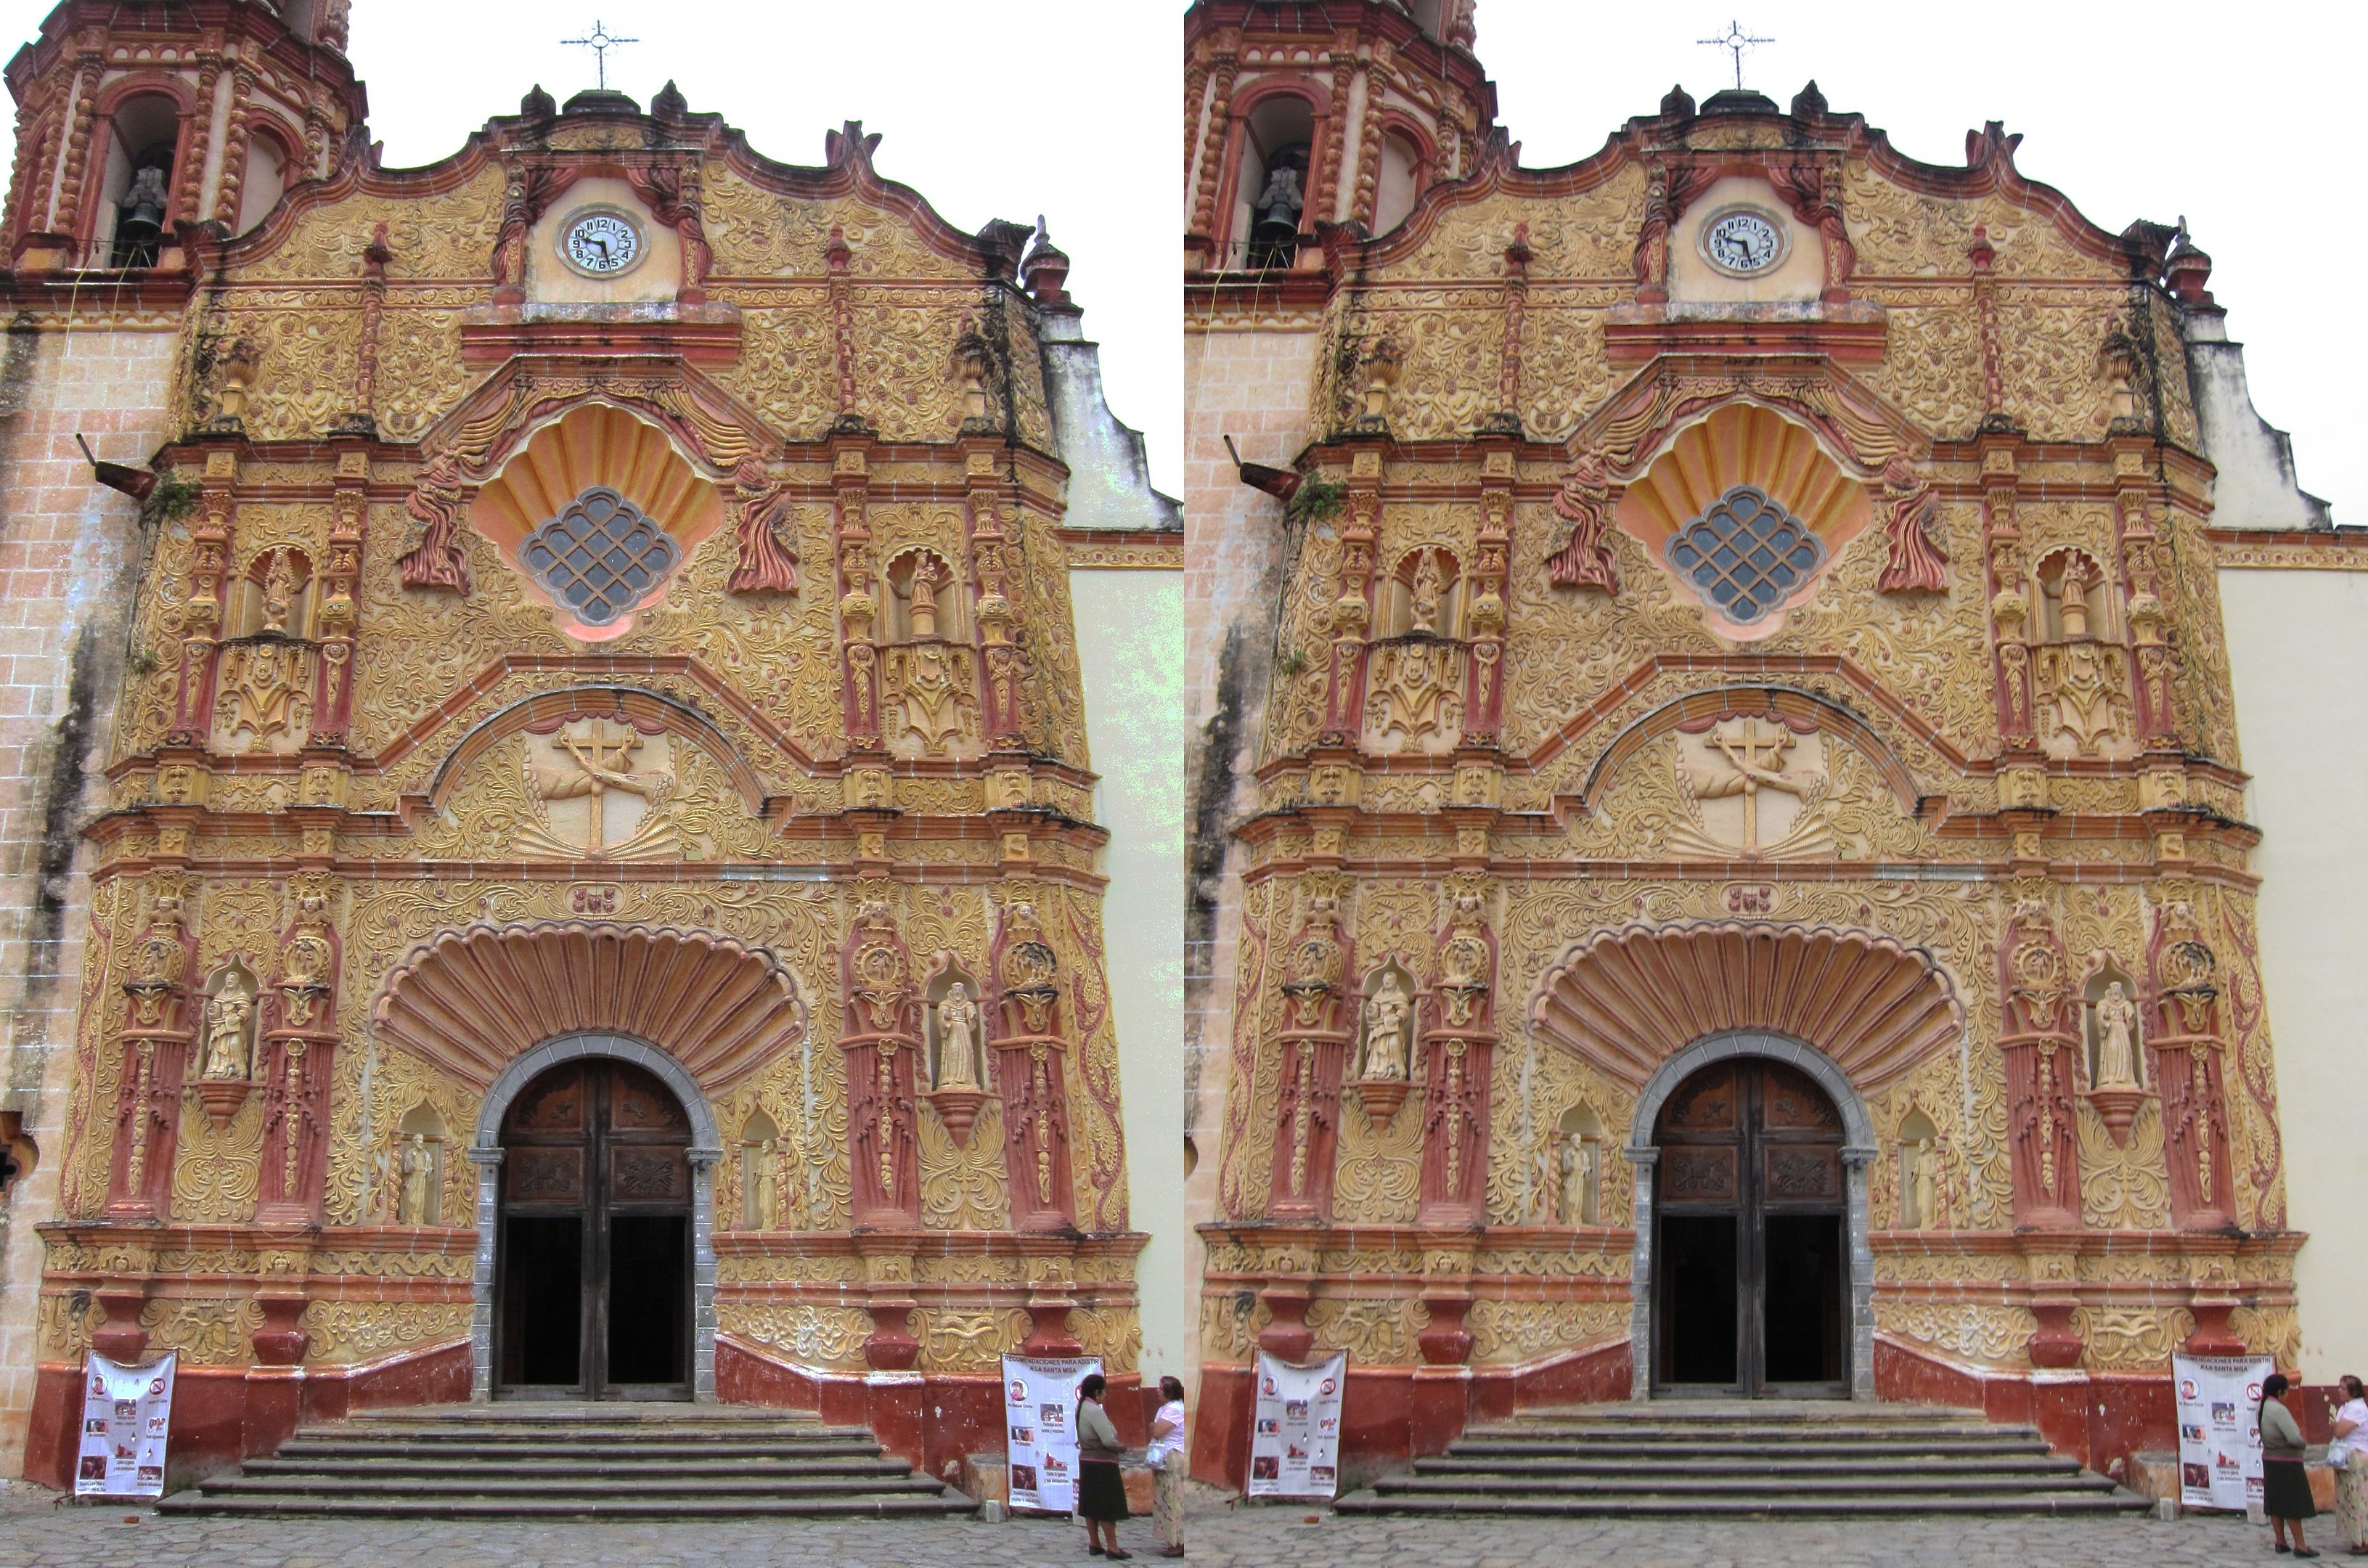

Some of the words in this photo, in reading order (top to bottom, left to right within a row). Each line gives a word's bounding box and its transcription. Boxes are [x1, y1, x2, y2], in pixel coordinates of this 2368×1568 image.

[587, 221, 593, 231] 11
[597, 219, 608, 228] 12
[613, 222, 616, 231] 1
[575, 229, 584, 238] 10
[621, 229, 628, 239] 2
[573, 240, 580, 248] 9
[576, 250, 583, 258] 8
[621, 250, 629, 260] 4
[587, 258, 594, 266] 7
[599, 260, 606, 269] 6
[611, 258, 618, 266] 5
[1005, 1355, 1061, 1365] RECOMENDACIONES
